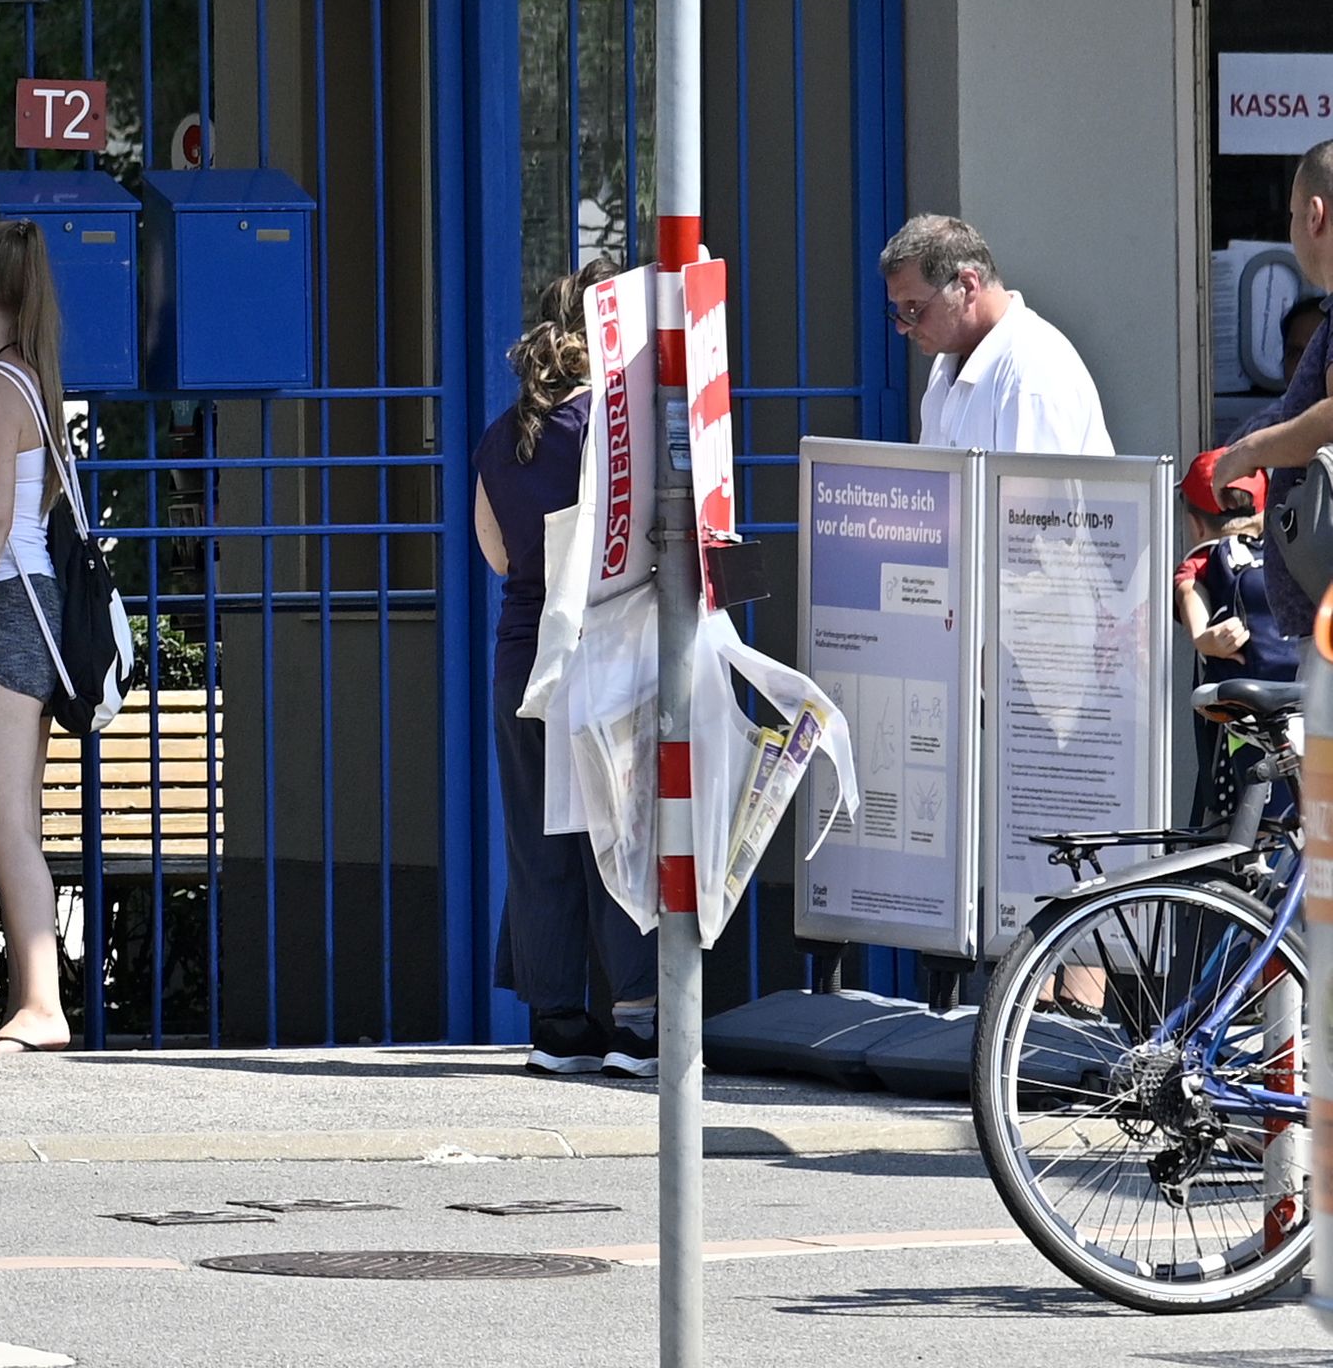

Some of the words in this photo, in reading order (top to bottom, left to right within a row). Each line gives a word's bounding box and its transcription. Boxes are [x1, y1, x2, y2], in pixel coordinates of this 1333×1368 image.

[33, 89, 90, 139] T2
[1230, 94, 1309, 117] KASSA
[1317, 94, 1330, 117] 3
[596, 280, 632, 578] ÖSTERREICH
[817, 481, 833, 503] So
[834, 483, 888, 508] schützen
[890, 487, 909, 510] Sie
[910, 489, 935, 512] sich
[816, 518, 838, 536] vor
[839, 514, 866, 538] dem
[868, 517, 942, 545] Coronavirus
[1009, 509, 1061, 530] Baderegeln
[1067, 511, 1114, 530] COVID-19
[812, 884, 828, 896] Stadt
[812, 896, 827, 908] Wien
[1000, 903, 1016, 916] Stadt
[1000, 916, 1016, 928] Wien
